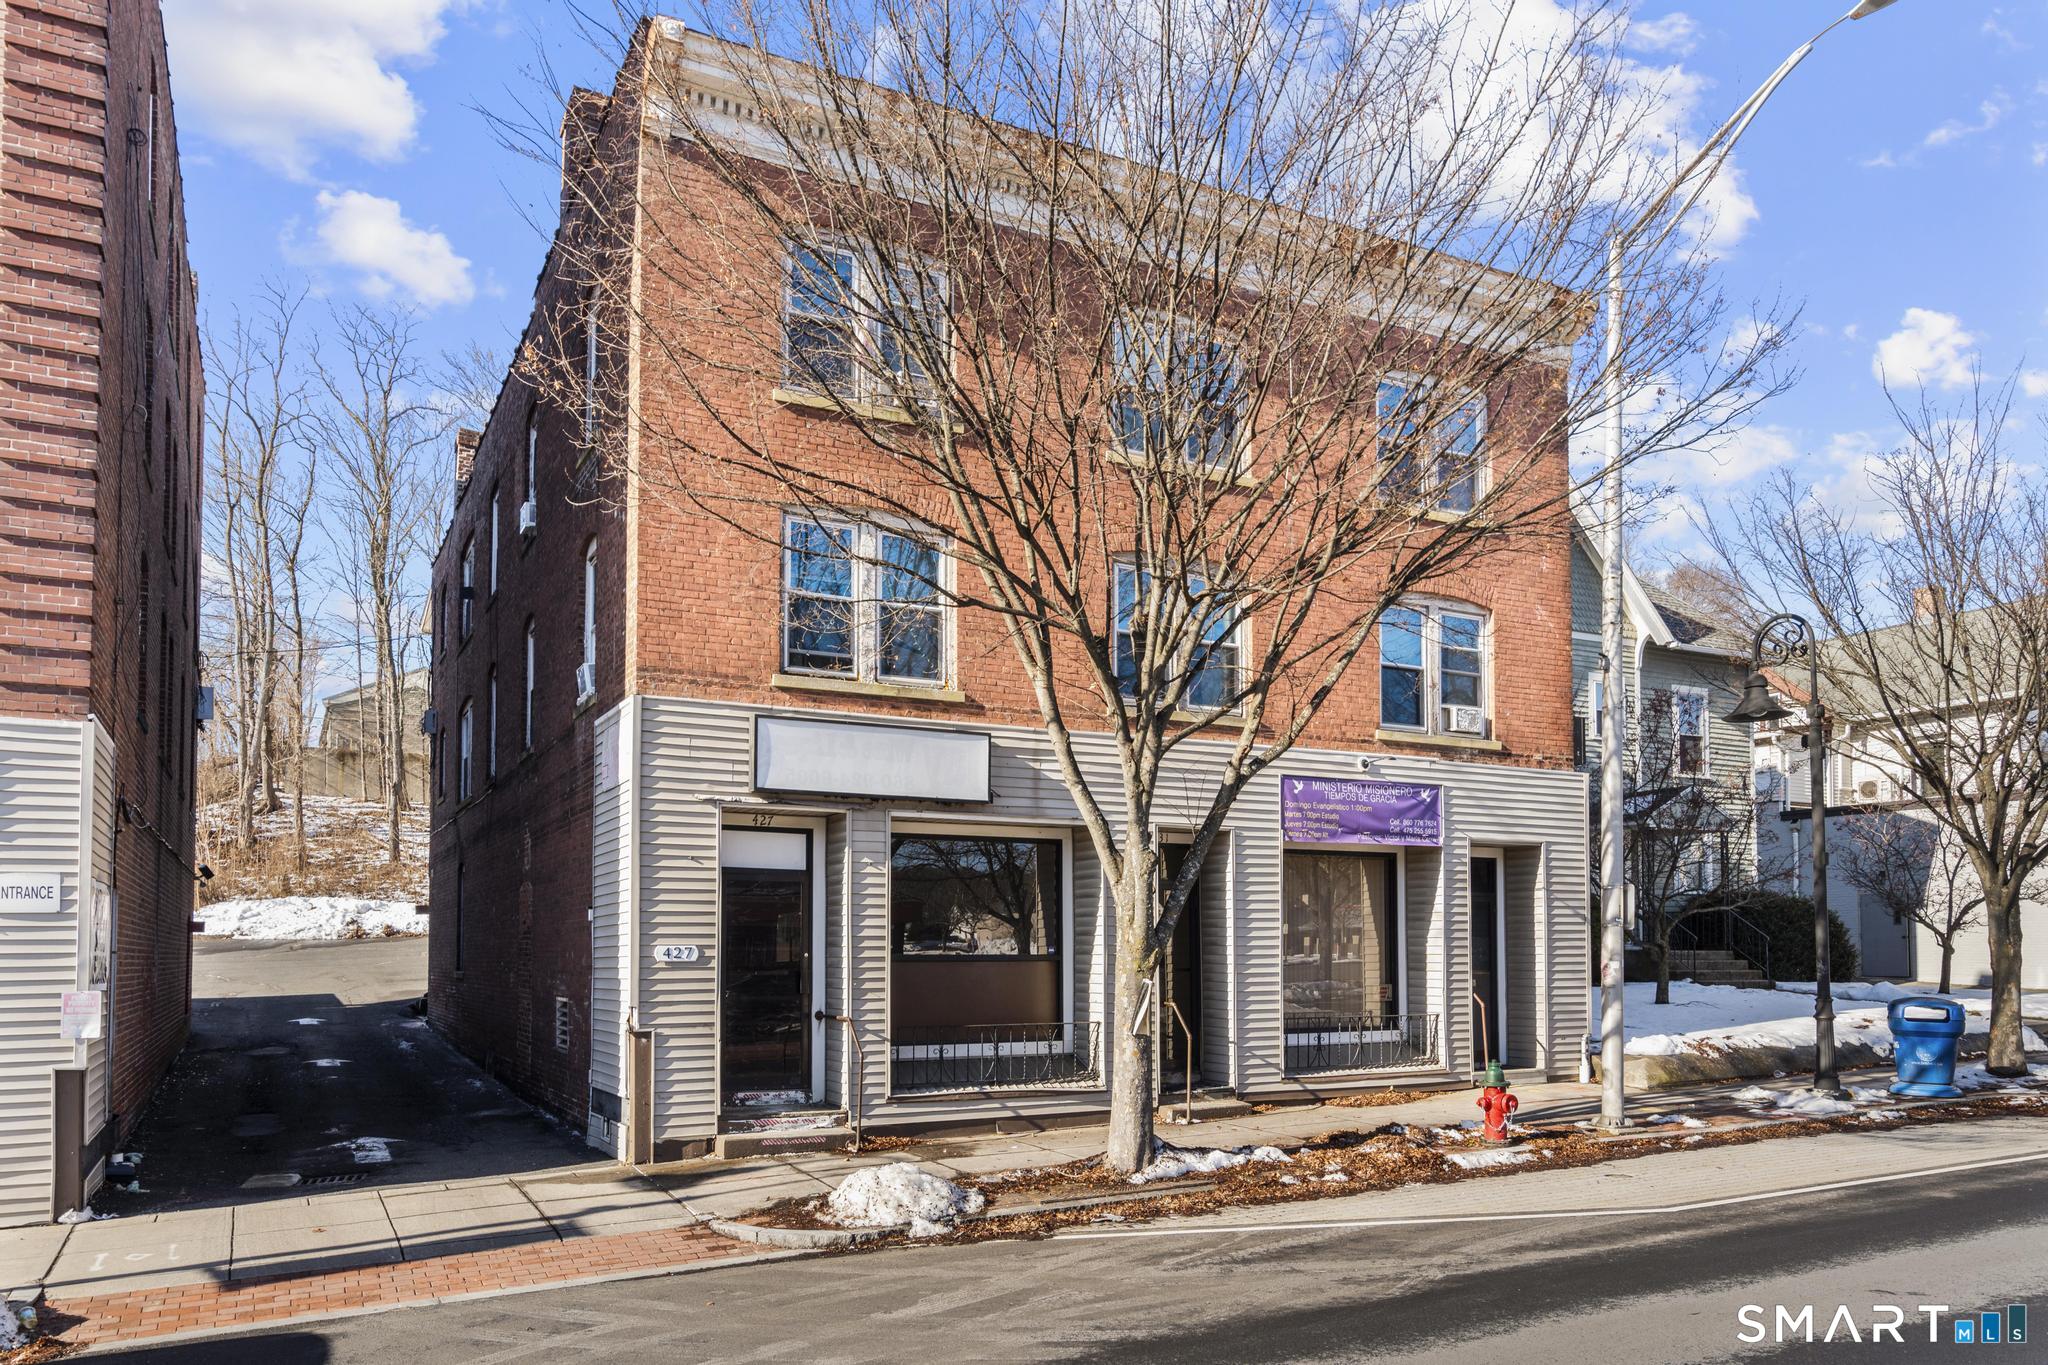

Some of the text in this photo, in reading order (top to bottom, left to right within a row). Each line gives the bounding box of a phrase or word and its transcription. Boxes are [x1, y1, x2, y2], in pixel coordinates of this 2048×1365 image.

[1312, 780, 1413, 797] MINISTERIO MISIONERO
[1324, 791, 1397, 804] TIEMPOS DE GRACIA
[1284, 801, 1312, 809] Domingo
[1351, 804, 1373, 813] 1:00pm
[752, 814, 774, 827] 427
[1321, 812, 1339, 820] Estudio
[1284, 820, 1302, 828] Jueves
[662, 946, 693, 960] 427
